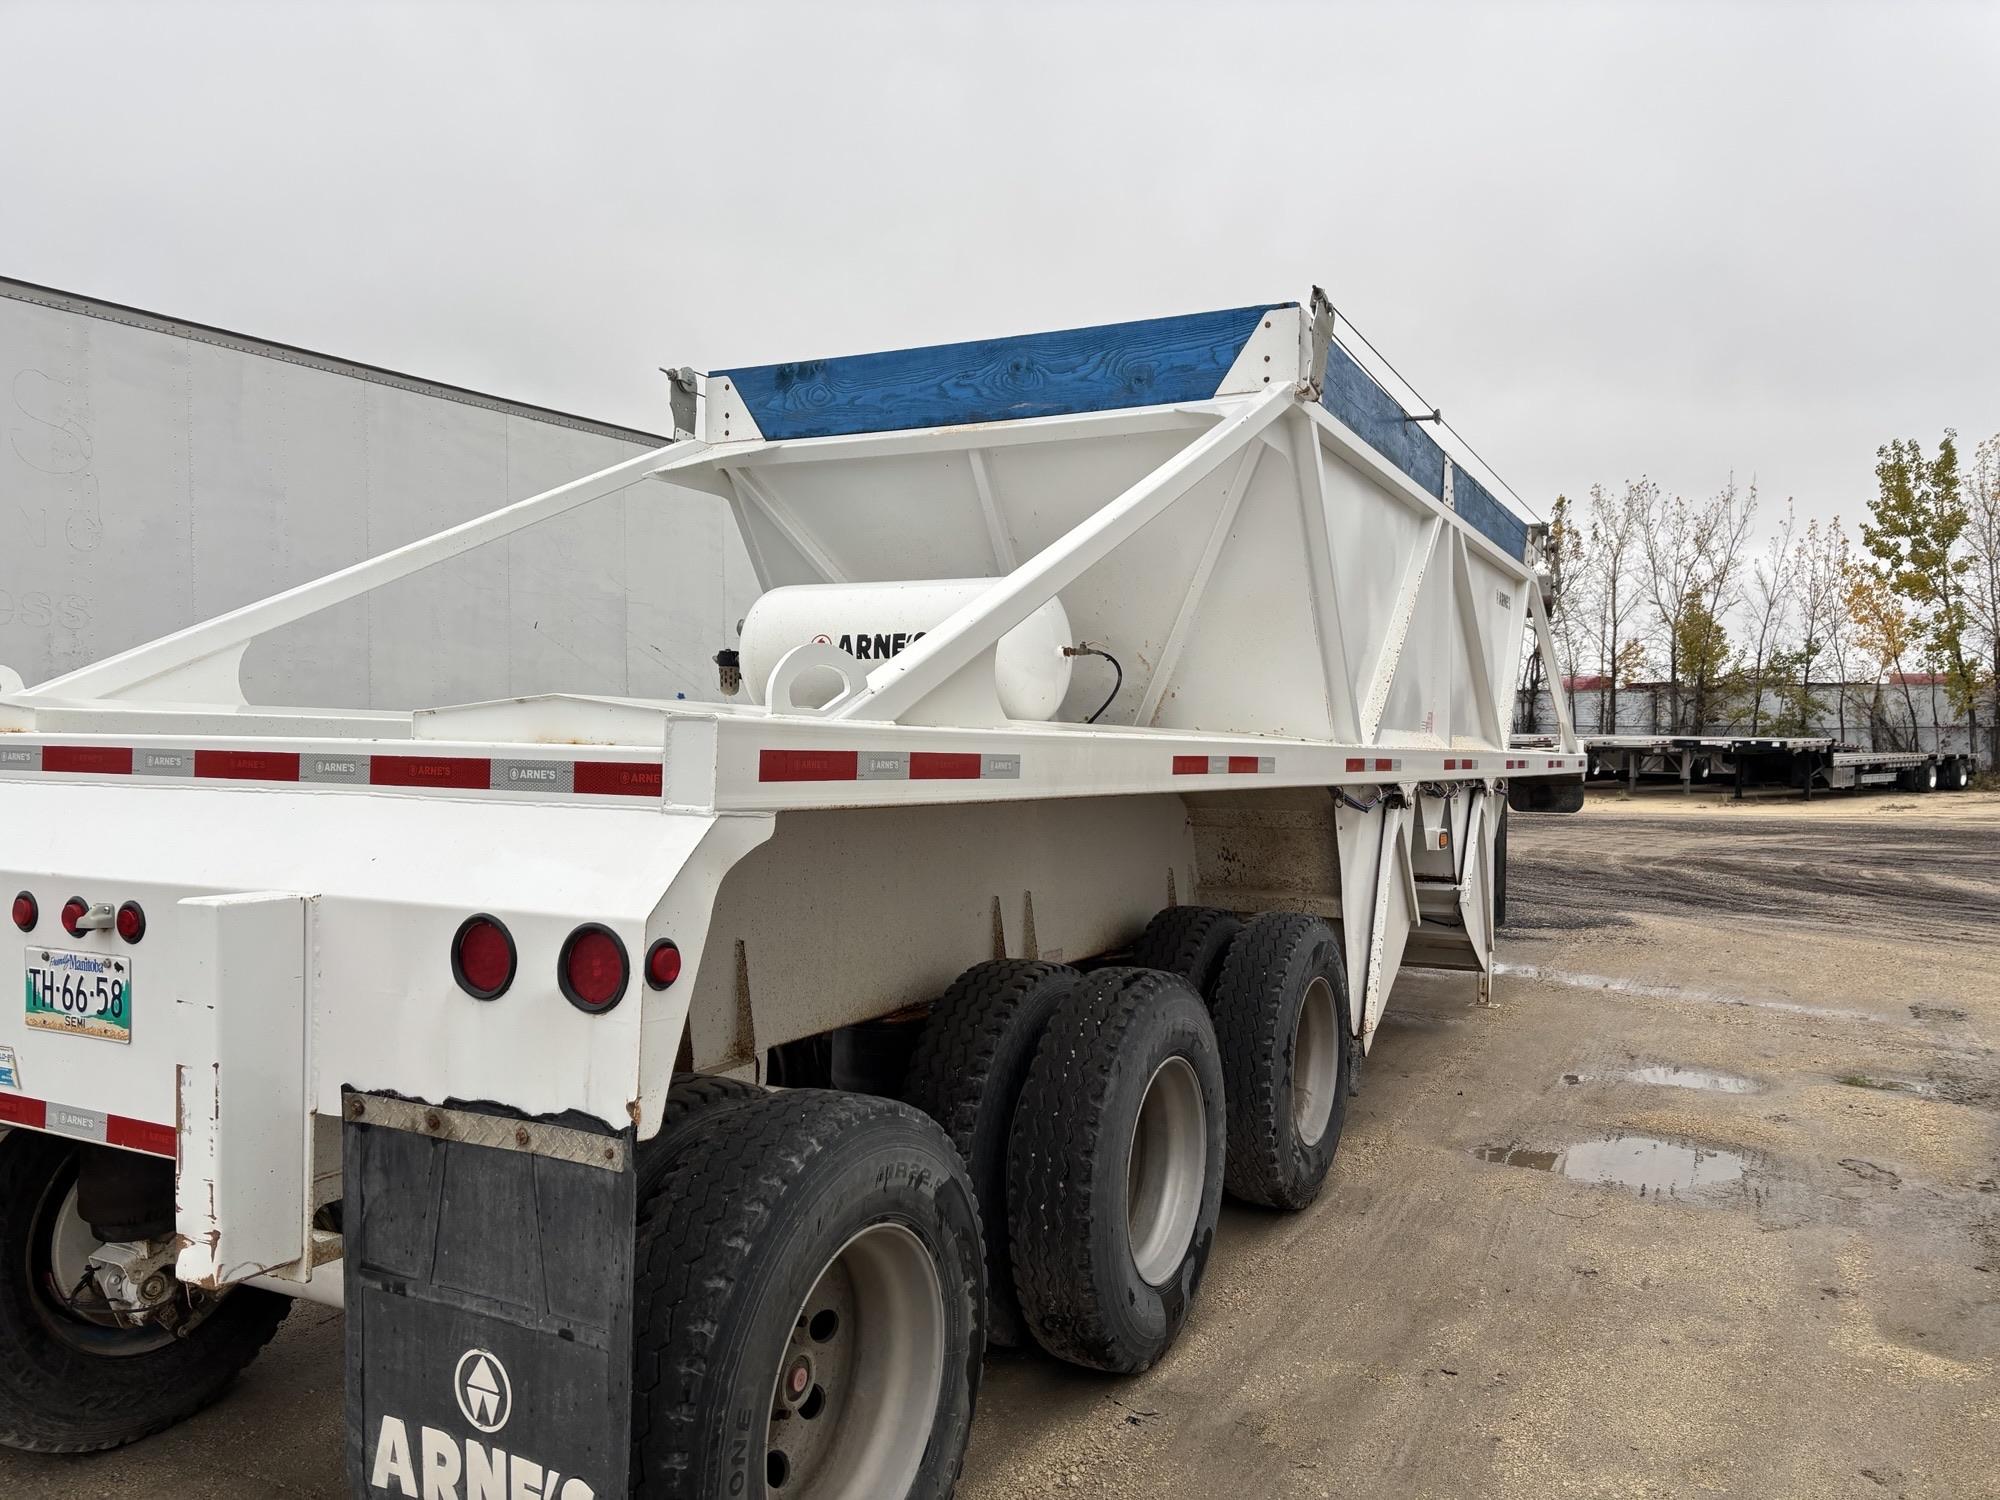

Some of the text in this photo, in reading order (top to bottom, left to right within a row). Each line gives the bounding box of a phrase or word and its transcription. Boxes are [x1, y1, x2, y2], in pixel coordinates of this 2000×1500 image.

[7, 751, 31, 762] ARNE'S
[153, 755, 182, 767] ARNE'S
[323, 761, 356, 773] ARNE'S
[416, 765, 452, 777] ARNE'S
[876, 760, 900, 770] ARNE'S
[518, 768, 556, 780] ARNE'S
[70, 954, 104, 973] Manitoba
[65, 1015, 86, 1029] SEMI
[67, 1114, 94, 1128] ARNE'S
